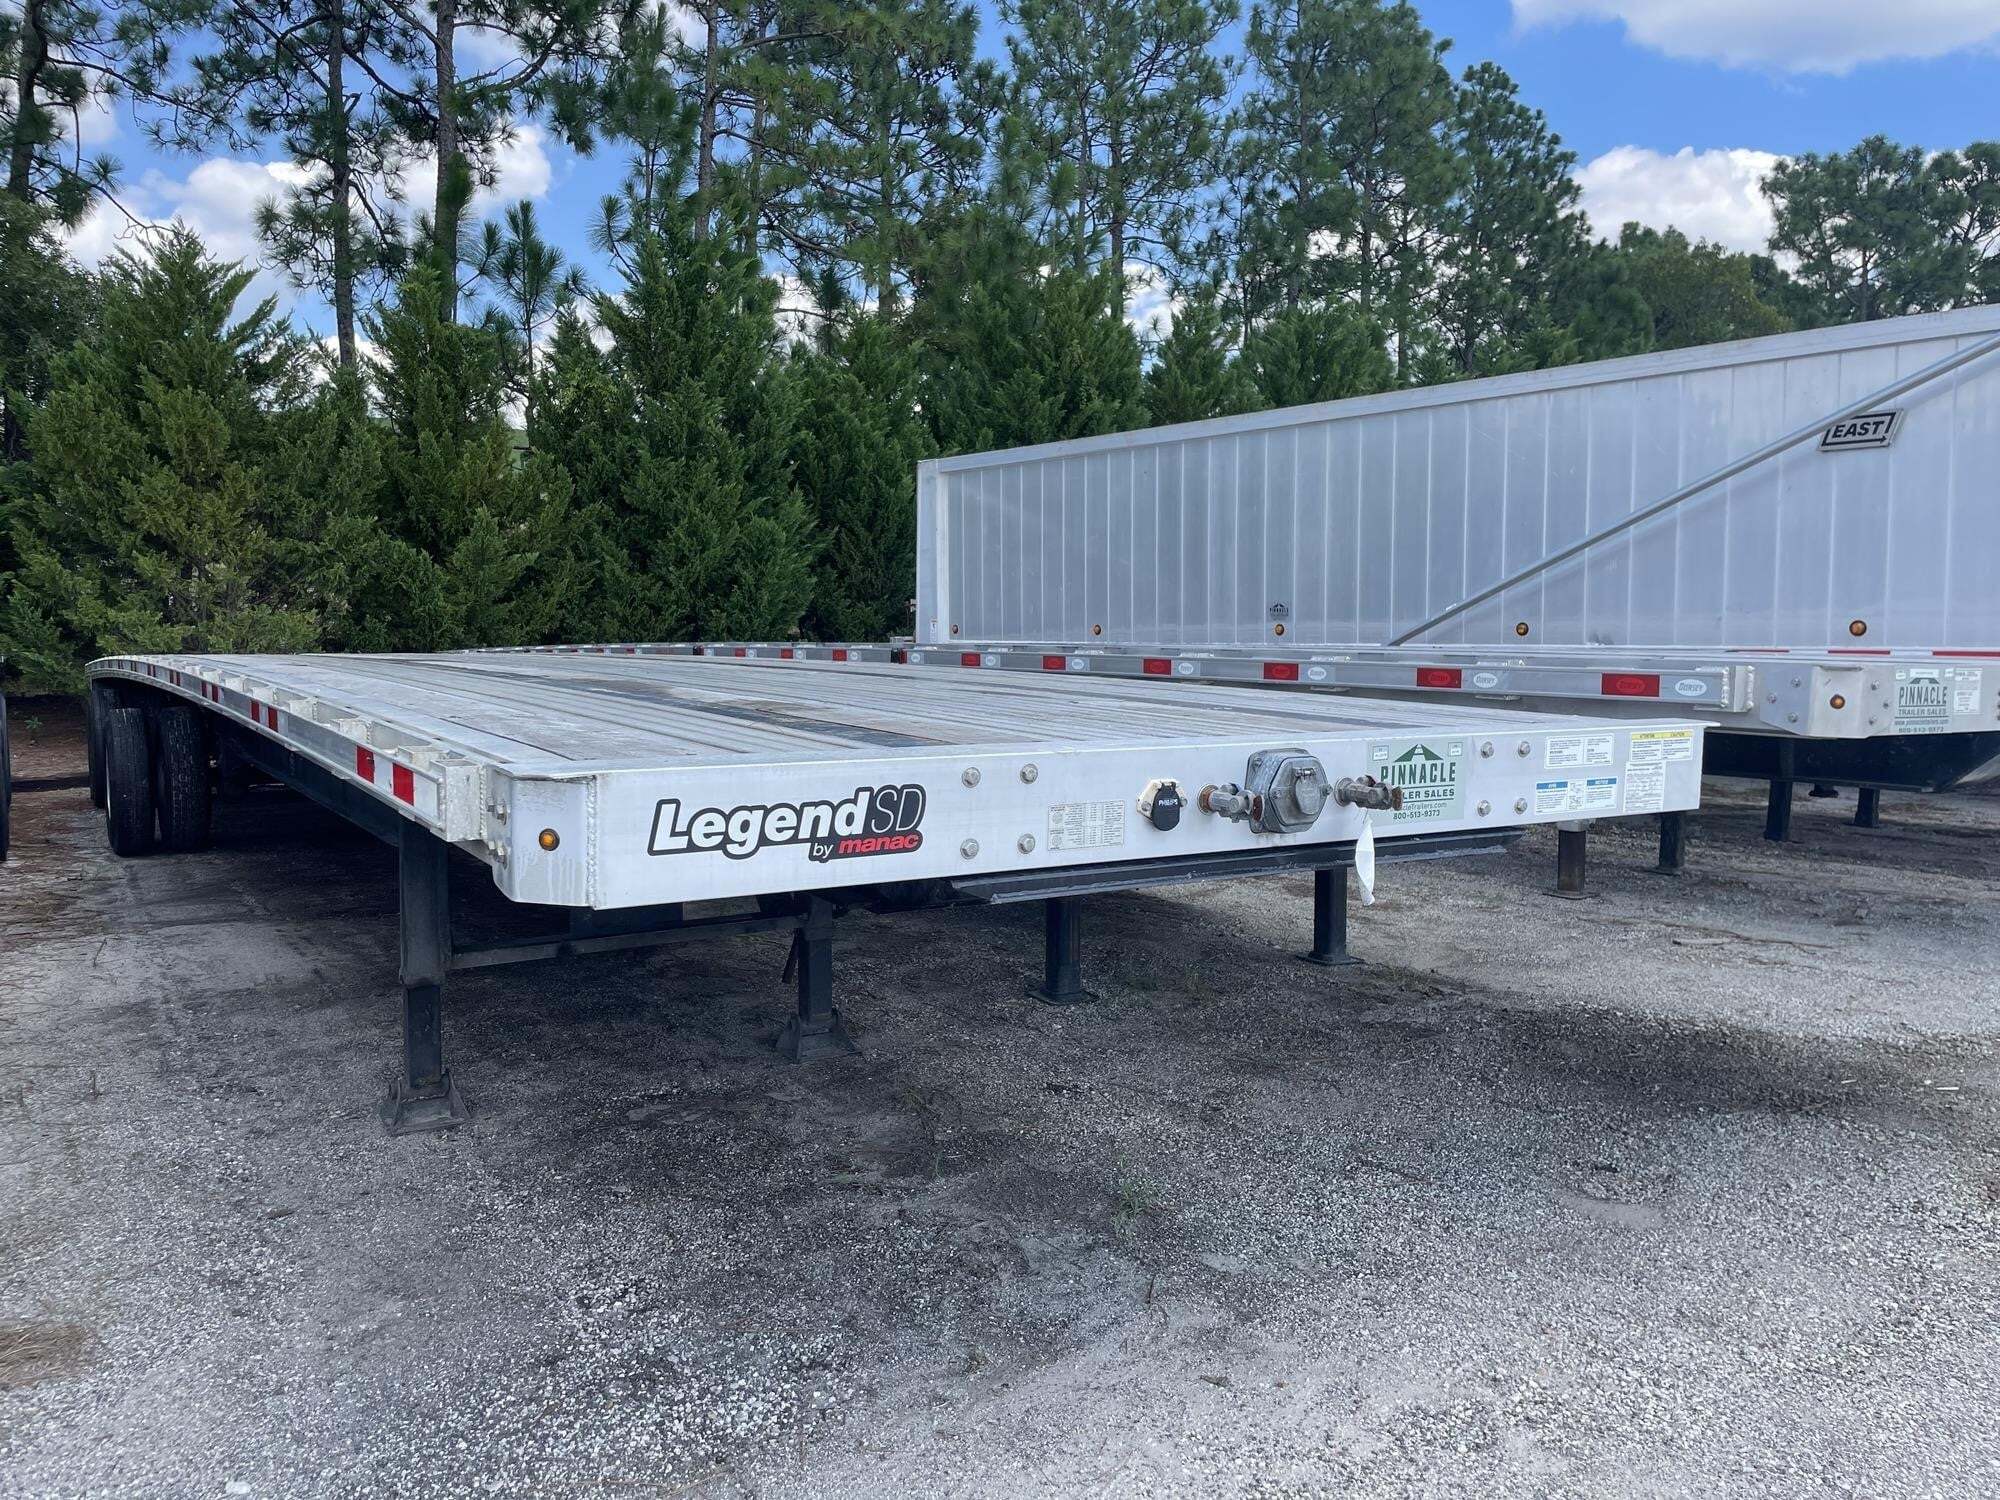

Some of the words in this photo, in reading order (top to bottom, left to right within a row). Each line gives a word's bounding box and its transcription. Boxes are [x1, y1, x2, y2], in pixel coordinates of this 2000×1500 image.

[1832, 421, 1885, 438] EAST
[1899, 686, 1948, 704] PINNACLE
[1898, 708, 1925, 716] TRAILER
[1927, 707, 1947, 715] SALES
[1380, 762, 1456, 785] PINNACLE
[1424, 788, 1455, 798] SALES
[652, 790, 871, 855] Legend
[1393, 809, 1440, 820] 800-513-9373
[812, 842, 833, 858] by
[838, 833, 920, 854] manac
